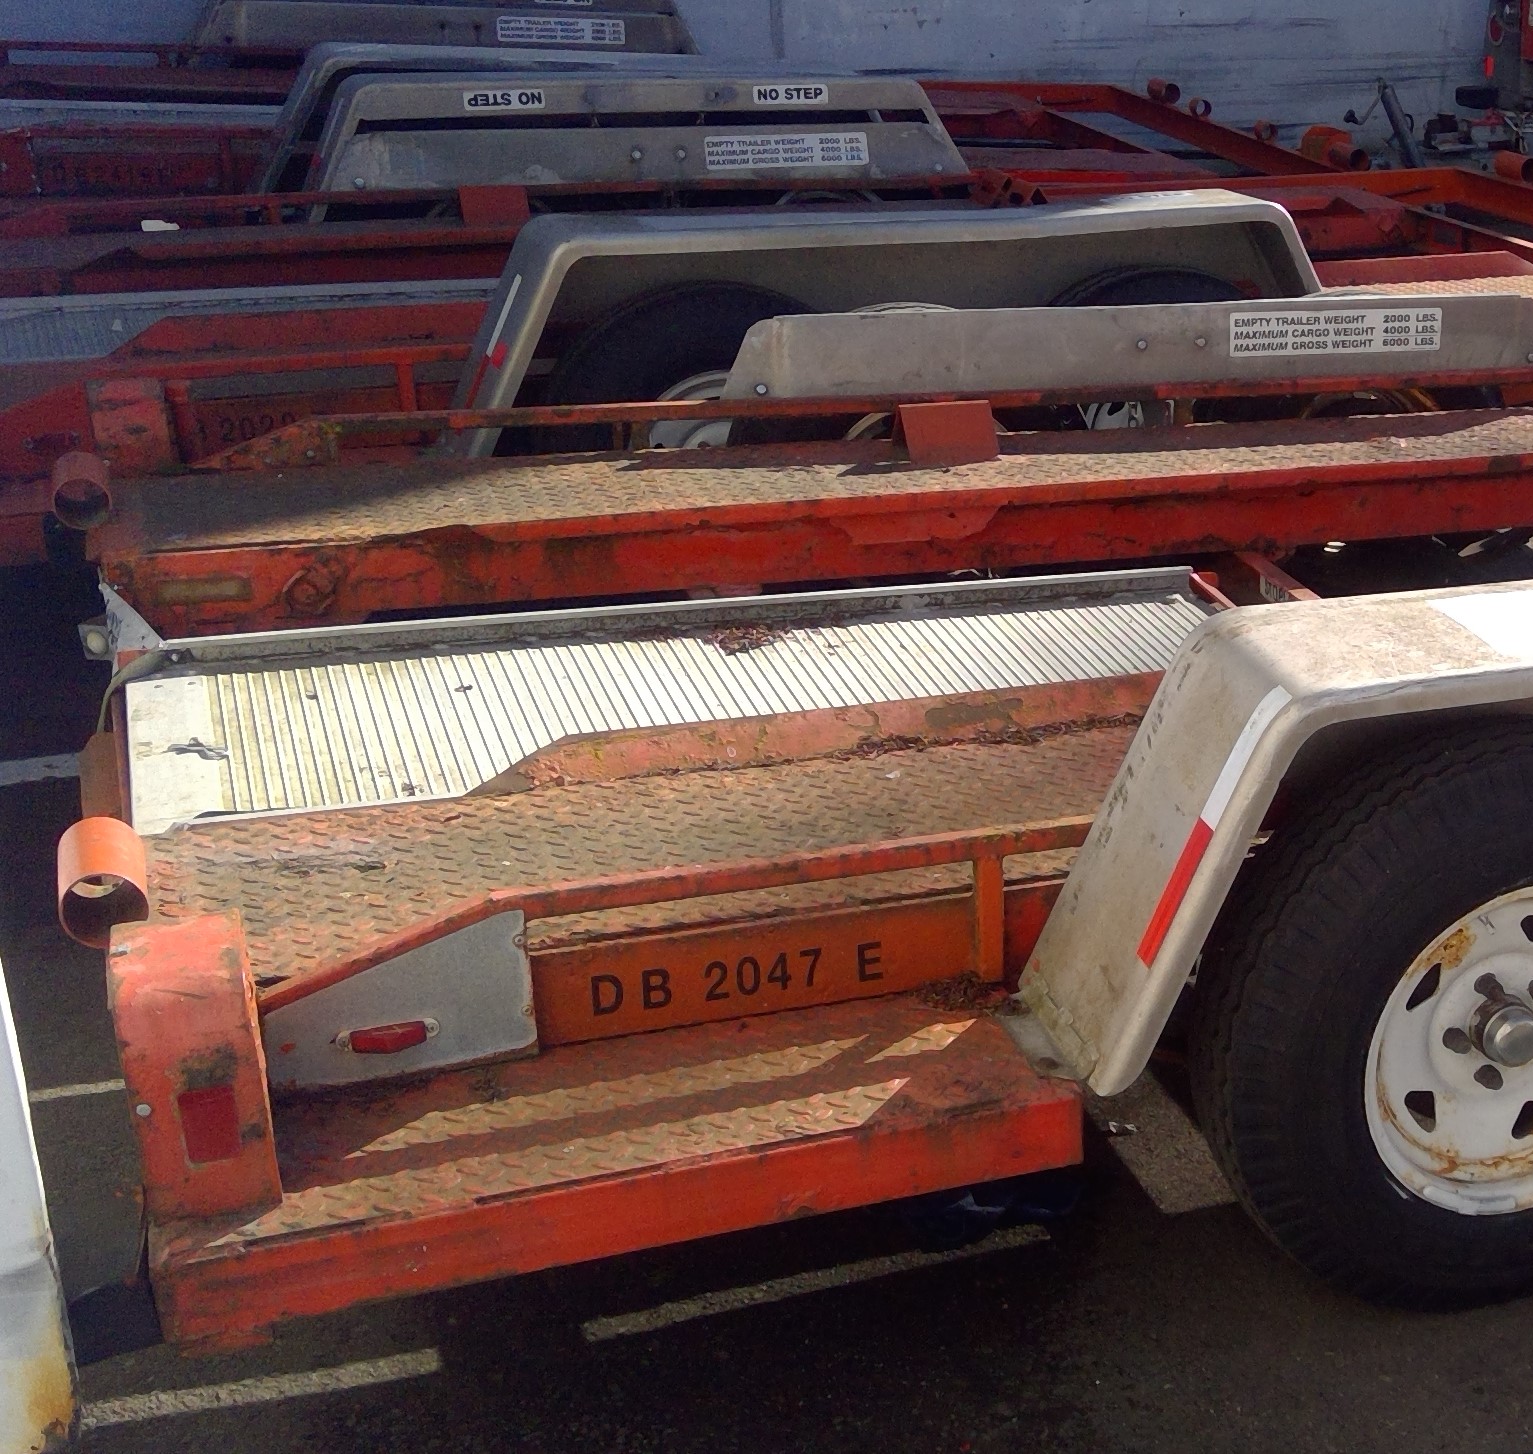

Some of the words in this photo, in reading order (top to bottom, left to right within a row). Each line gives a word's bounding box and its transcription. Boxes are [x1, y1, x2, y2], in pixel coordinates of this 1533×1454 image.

[467, 92, 512, 107] STEP
[518, 91, 543, 105] NO
[757, 88, 780, 101] NO
[784, 87, 823, 100] STEP
[706, 140, 735, 149] EMPTY
[737, 139, 772, 147] TRAILER
[774, 138, 806, 146] WEIGHT
[818, 137, 840, 145] 2000
[844, 137, 862, 145] LBS.
[707, 149, 749, 157] MAXIMUM
[751, 148, 780, 156] CARGO
[782, 146, 815, 154] WEIGHT
[708, 158, 749, 166] MAXIMUM
[752, 156, 780, 165] GROSS
[782, 155, 815, 163] WEIGHT
[1234, 318, 1272, 328] EMPTY
[1274, 316, 1321, 326] TRAILER
[1324, 314, 1367, 325] WEIGHT
[1383, 314, 1411, 323] 2000
[1416, 313, 1439, 322] LBS.
[1234, 329, 1288, 340] MAXIMUM
[1291, 328, 1330, 338] CARGO
[1333, 326, 1376, 337] WEIGHT
[1383, 325, 1411, 335] 4000
[1416, 325, 1438, 334] LBS.
[1234, 342, 1288, 352] MAXIMUM
[1291, 340, 1329, 351] GROSS
[1331, 339, 1374, 349] WEIGHT
[1382, 338, 1410, 347] 6000
[1415, 337, 1438, 346] LBS.
[703, 946, 822, 1003] 2047
[857, 941, 884, 983] E
